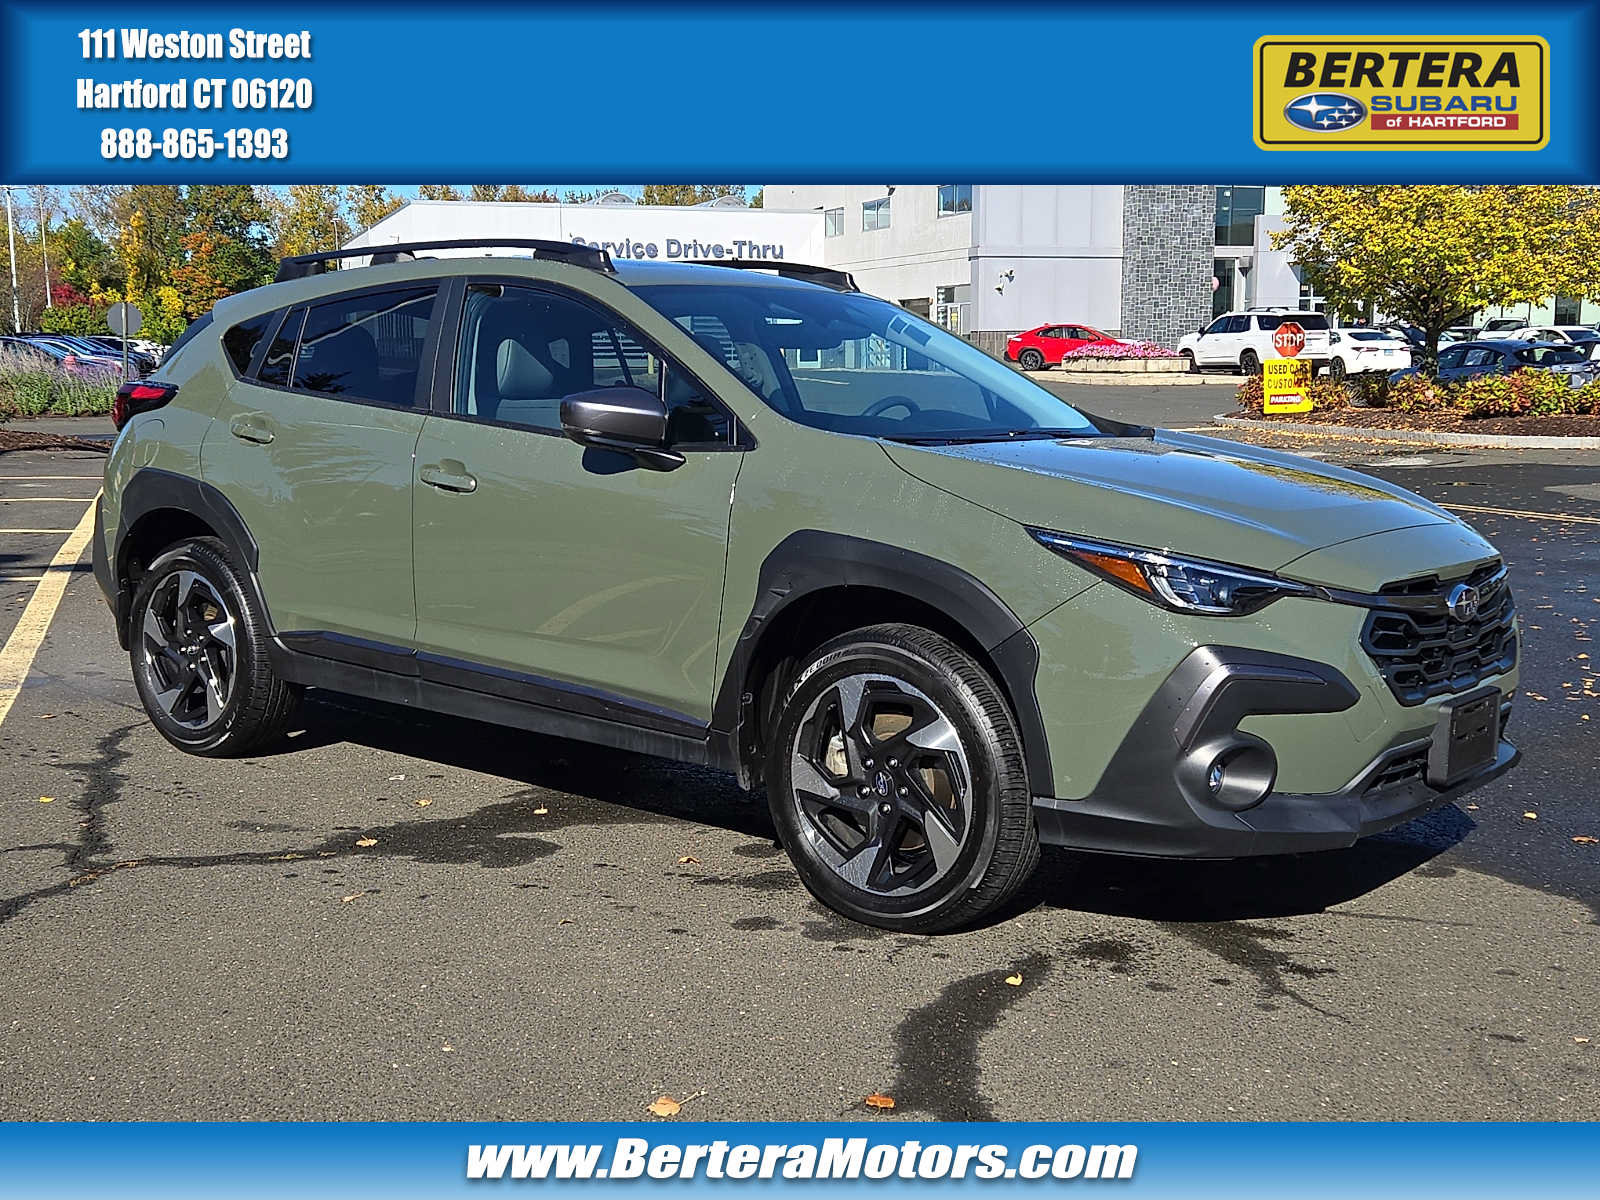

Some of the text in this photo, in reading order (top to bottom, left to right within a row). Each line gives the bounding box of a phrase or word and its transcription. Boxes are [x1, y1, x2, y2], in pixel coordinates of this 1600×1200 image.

[665, 238, 785, 260] Drive-Thru
[1275, 334, 1304, 347] STOP
[1268, 364, 1288, 375] USED
